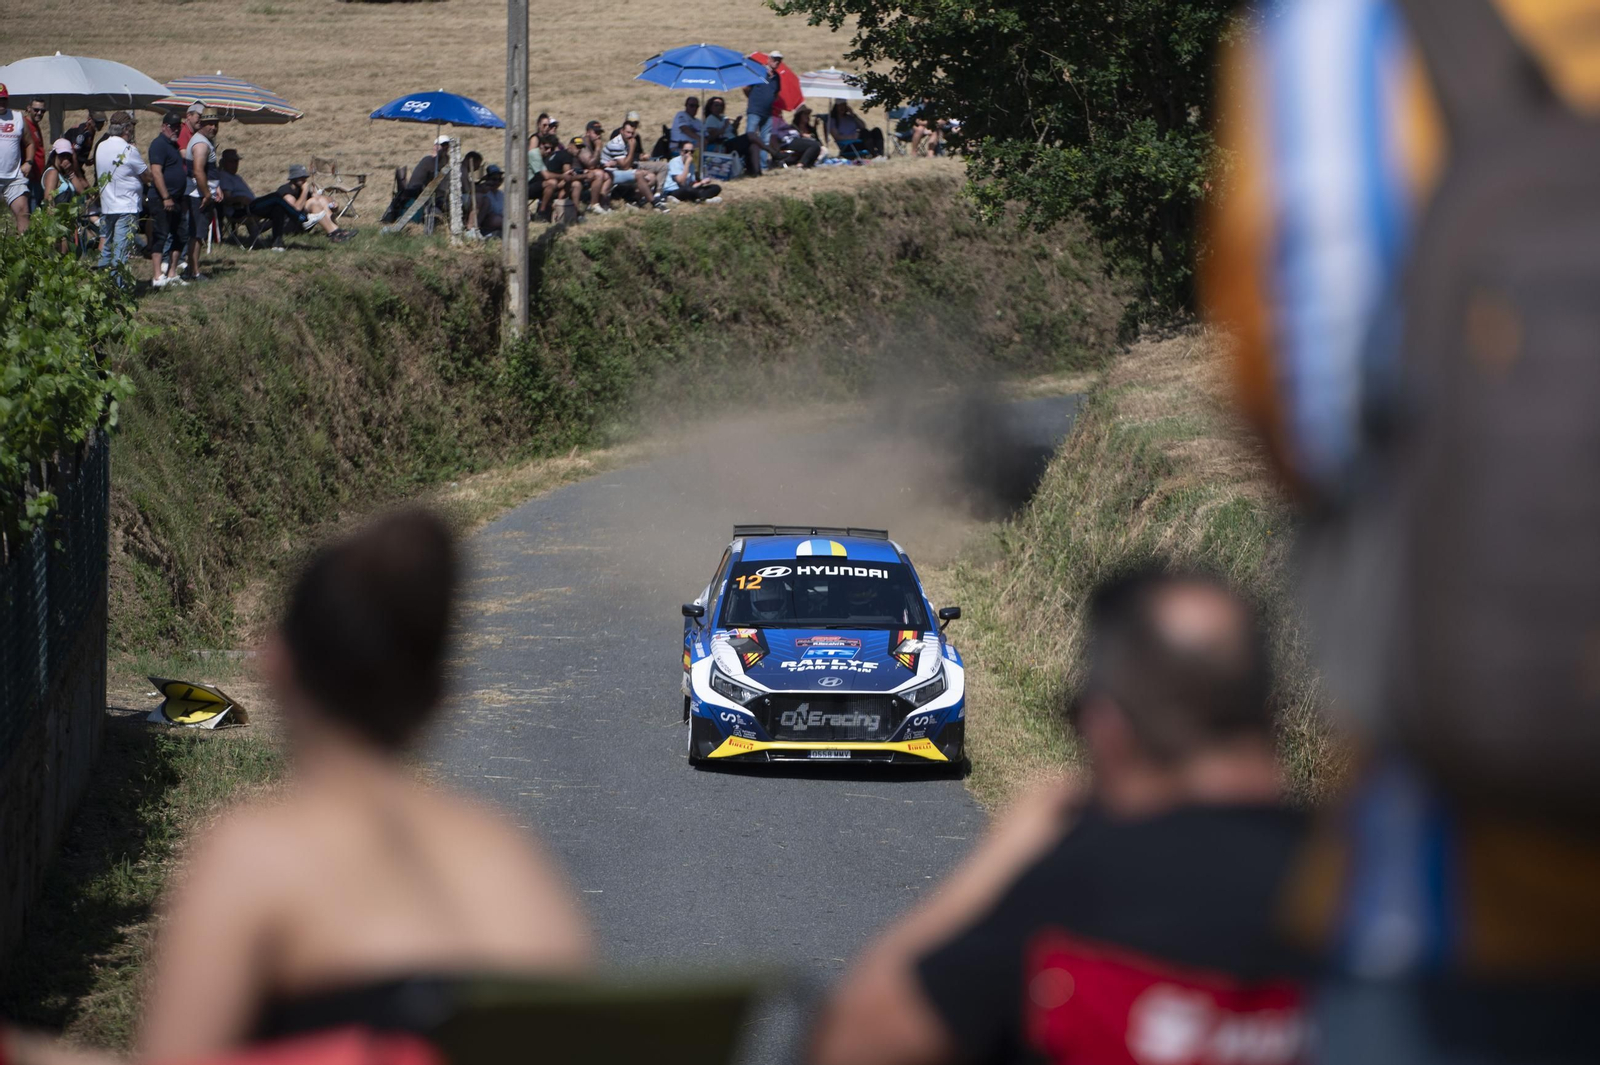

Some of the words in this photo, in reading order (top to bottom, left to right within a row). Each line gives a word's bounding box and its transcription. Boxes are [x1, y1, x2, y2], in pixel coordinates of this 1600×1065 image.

[797, 565, 889, 578] HYUNDAI
[735, 575, 762, 590] 12
[780, 659, 879, 669] RALLYE
[830, 665, 872, 673] SPAIN
